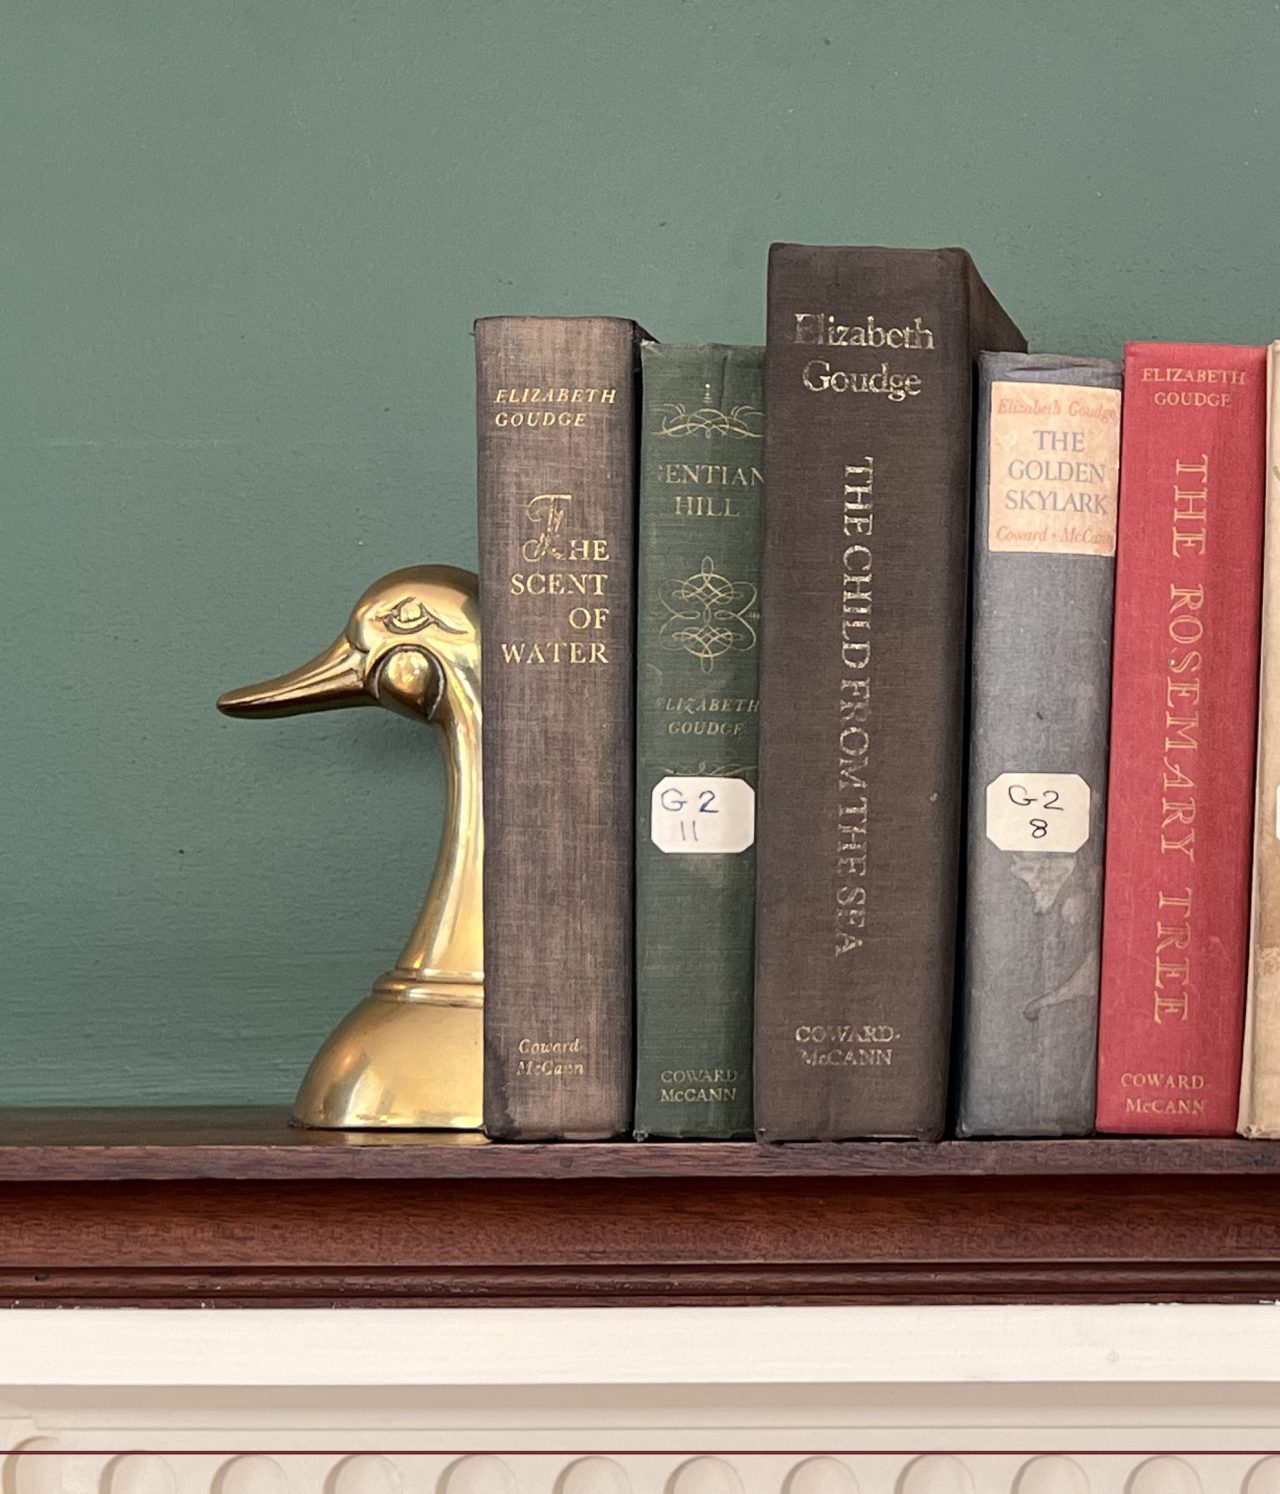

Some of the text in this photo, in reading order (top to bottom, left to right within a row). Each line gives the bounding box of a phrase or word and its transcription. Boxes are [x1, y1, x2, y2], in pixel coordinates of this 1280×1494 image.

[793, 313, 935, 351] Elizabeth
[801, 360, 923, 402] Goudge
[1141, 367, 1247, 386] ELIZABETH
[494, 387, 617, 404] ELIZABETH
[1153, 391, 1231, 408] GOUDGE
[495, 411, 587, 428] GOUDGE
[997, 398, 1117, 423] Elizabeth Goudge
[1033, 430, 1086, 452] THE
[657, 464, 765, 487] ENTIAN
[1008, 459, 1107, 483] GOLDEN
[674, 496, 741, 518] HILL
[1004, 489, 1109, 515] SKYLARK
[996, 525, 1048, 542] Coward
[511, 573, 609, 597] SCENT
[568, 607, 610, 630] OF
[501, 642, 610, 664] WATER
[834, 456, 874, 957] THE CHILD FROM THE SEA
[668, 721, 746, 736] GOUDGE
[1152, 453, 1210, 1025] THE ROSEMARY TREE
[1029, 818, 1048, 839] 8
[799, 1049, 893, 1067] McCANN
[660, 1069, 738, 1083] COWARD
[660, 1088, 737, 1102] McCANN
[1125, 1097, 1206, 1115] McCANN
